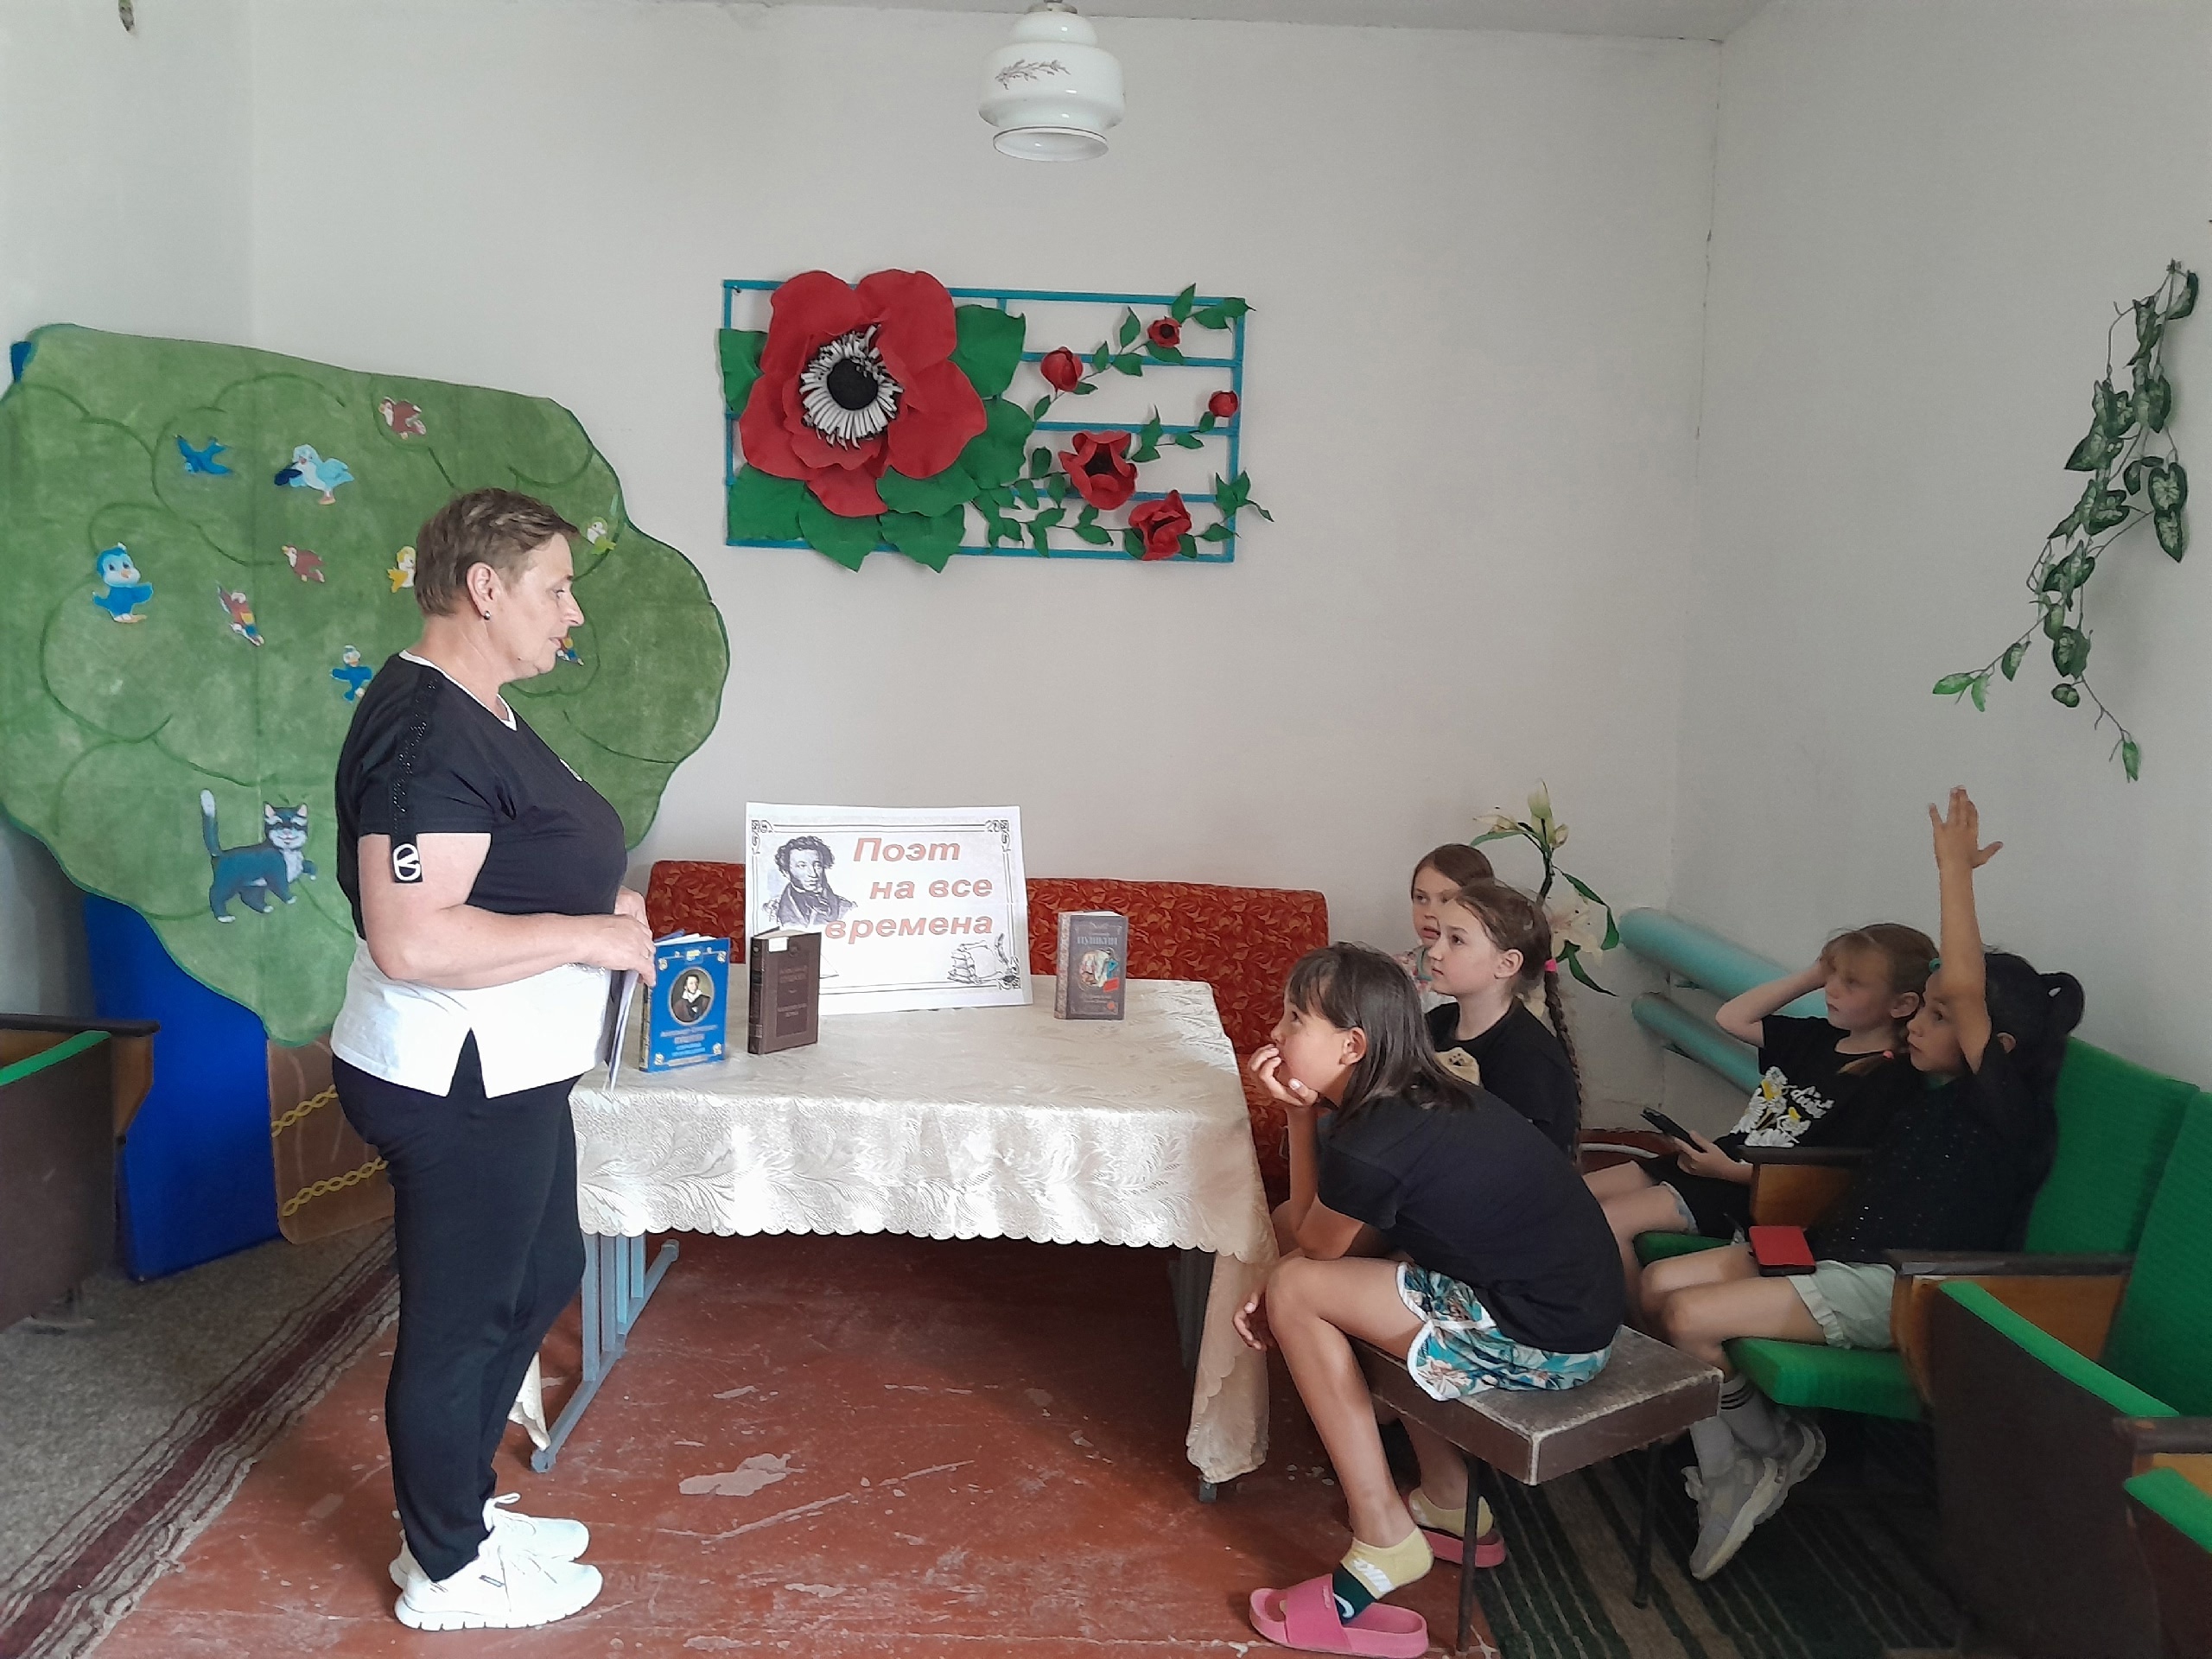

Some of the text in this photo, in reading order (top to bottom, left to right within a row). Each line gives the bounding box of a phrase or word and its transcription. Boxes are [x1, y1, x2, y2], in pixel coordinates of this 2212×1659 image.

[853, 837, 961, 862] Поэт
[869, 879, 993, 899] на все
[824, 915, 993, 944] времена
